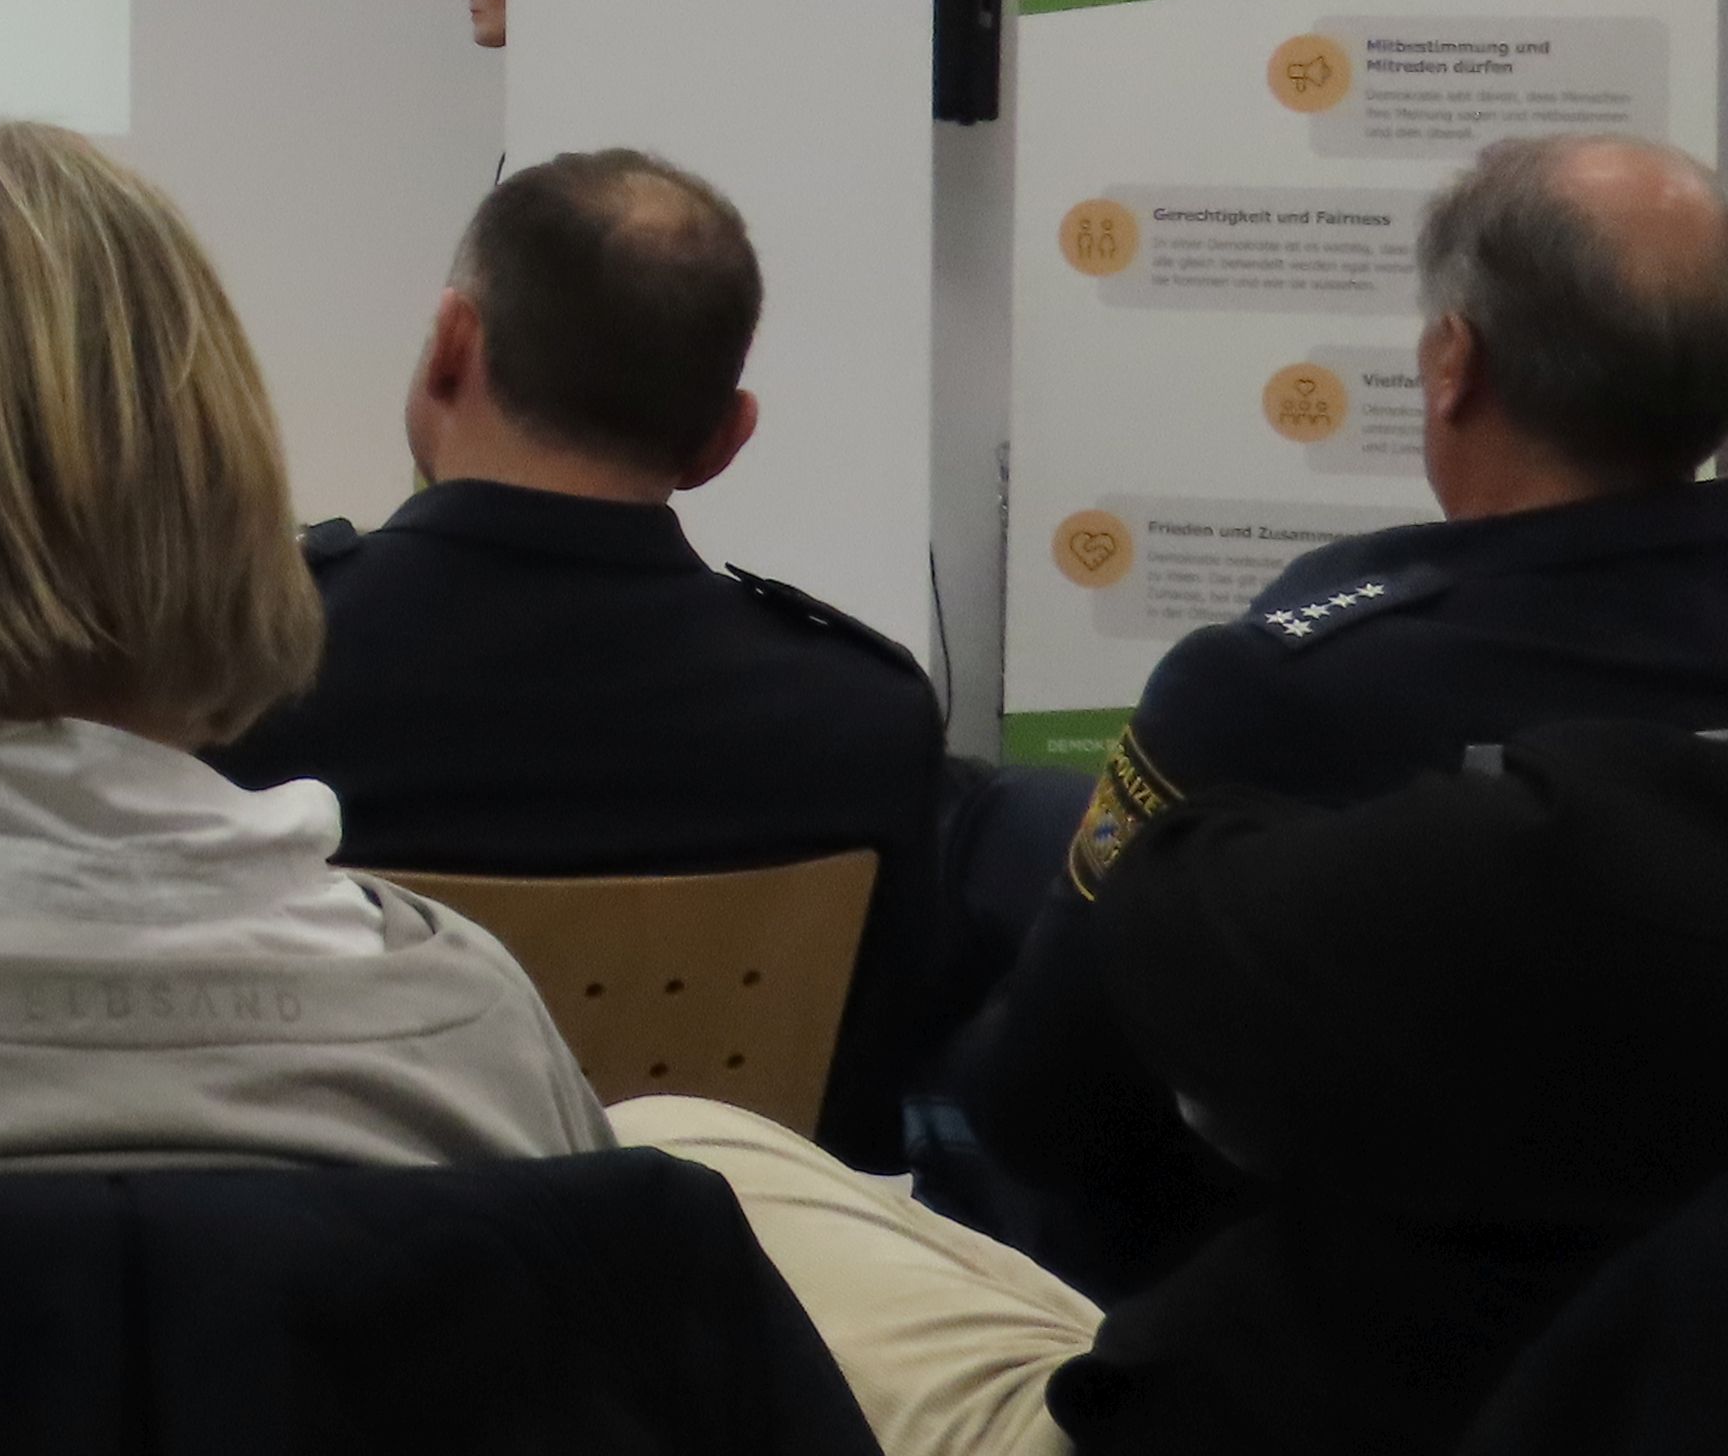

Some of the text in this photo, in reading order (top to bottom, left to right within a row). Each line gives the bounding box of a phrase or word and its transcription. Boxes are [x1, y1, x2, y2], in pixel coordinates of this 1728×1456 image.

[1153, 208, 1392, 226] Gerechtigkeit und Fairness
[1148, 521, 1214, 537] Frieden
[1220, 525, 1253, 538] und
